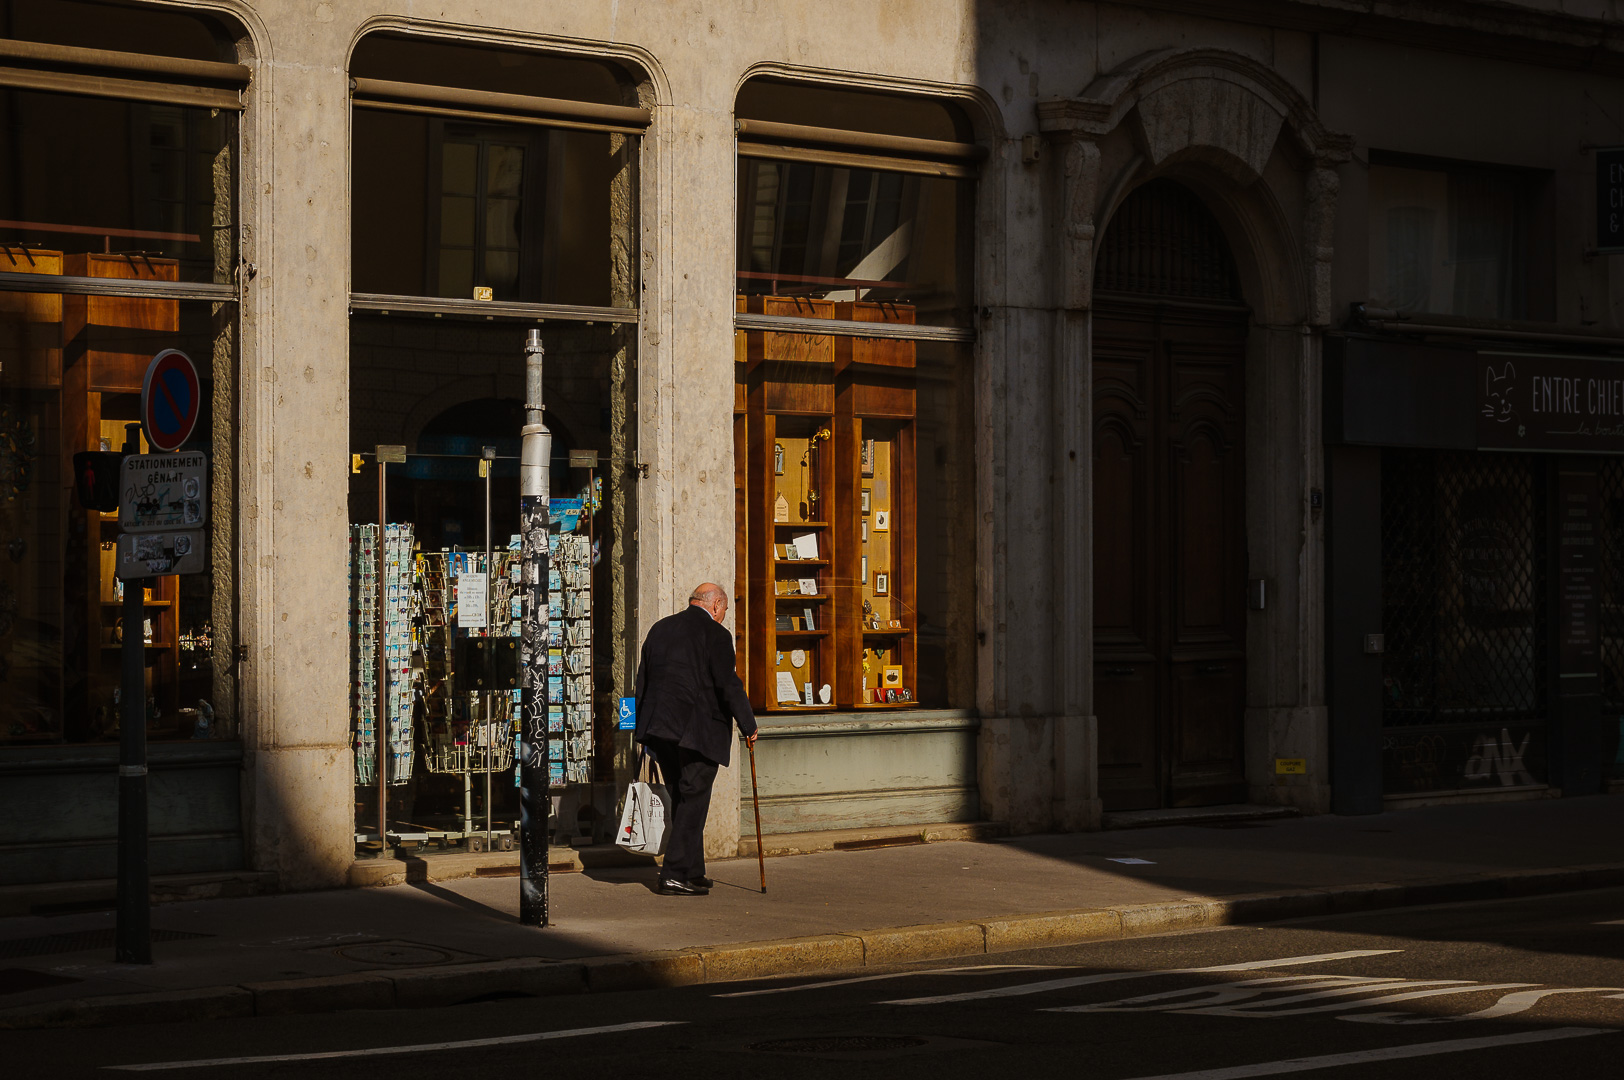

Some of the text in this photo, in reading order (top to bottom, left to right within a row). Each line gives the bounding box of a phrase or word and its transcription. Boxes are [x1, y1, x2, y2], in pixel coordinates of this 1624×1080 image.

[1532, 375, 1624, 416] ENTRE CHIE
[128, 457, 204, 470] STATIONNEMENT
[147, 471, 184, 484] GÊNANT
